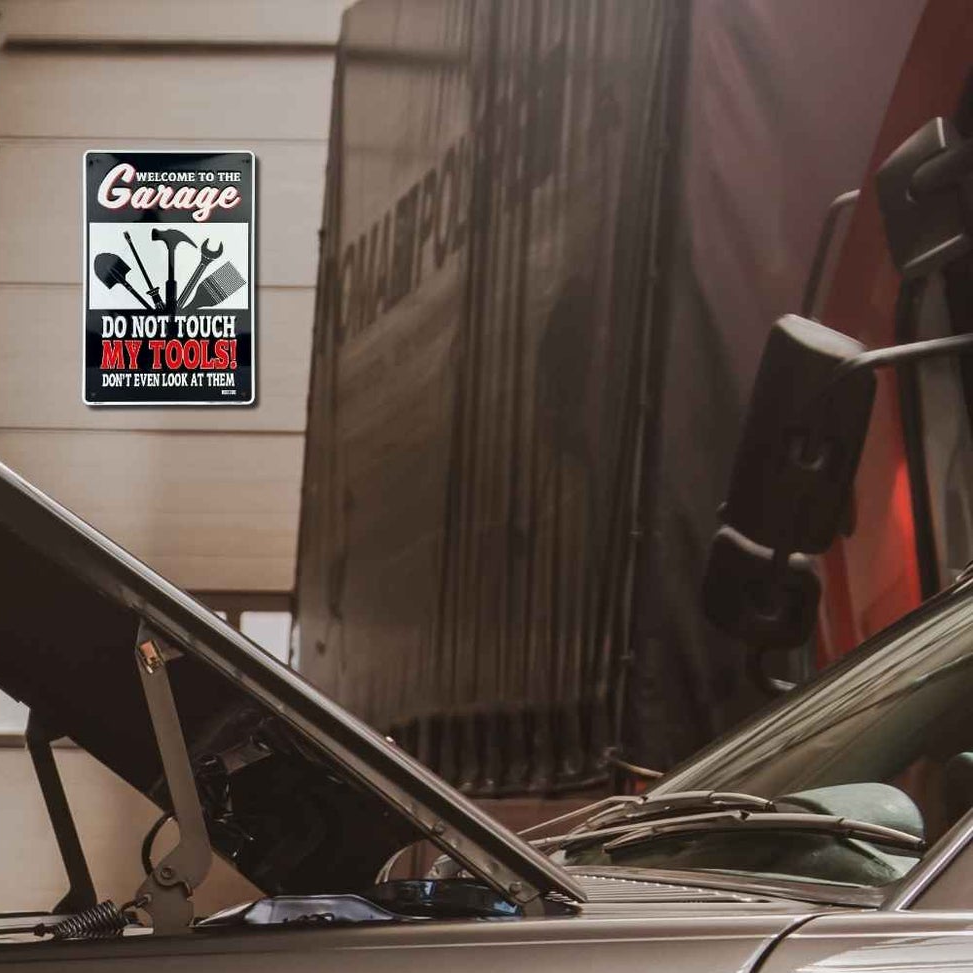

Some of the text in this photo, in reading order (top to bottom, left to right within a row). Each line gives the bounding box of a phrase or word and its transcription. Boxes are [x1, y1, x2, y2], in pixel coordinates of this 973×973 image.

[136, 172, 241, 182] WELCOME TO THE
[97, 163, 241, 222] Garage
[101, 315, 237, 338] DO NOT TOUCH
[100, 339, 238, 370] MY TOOLS!
[102, 373, 235, 387] DON'T EVEN LOOK AT THEM
